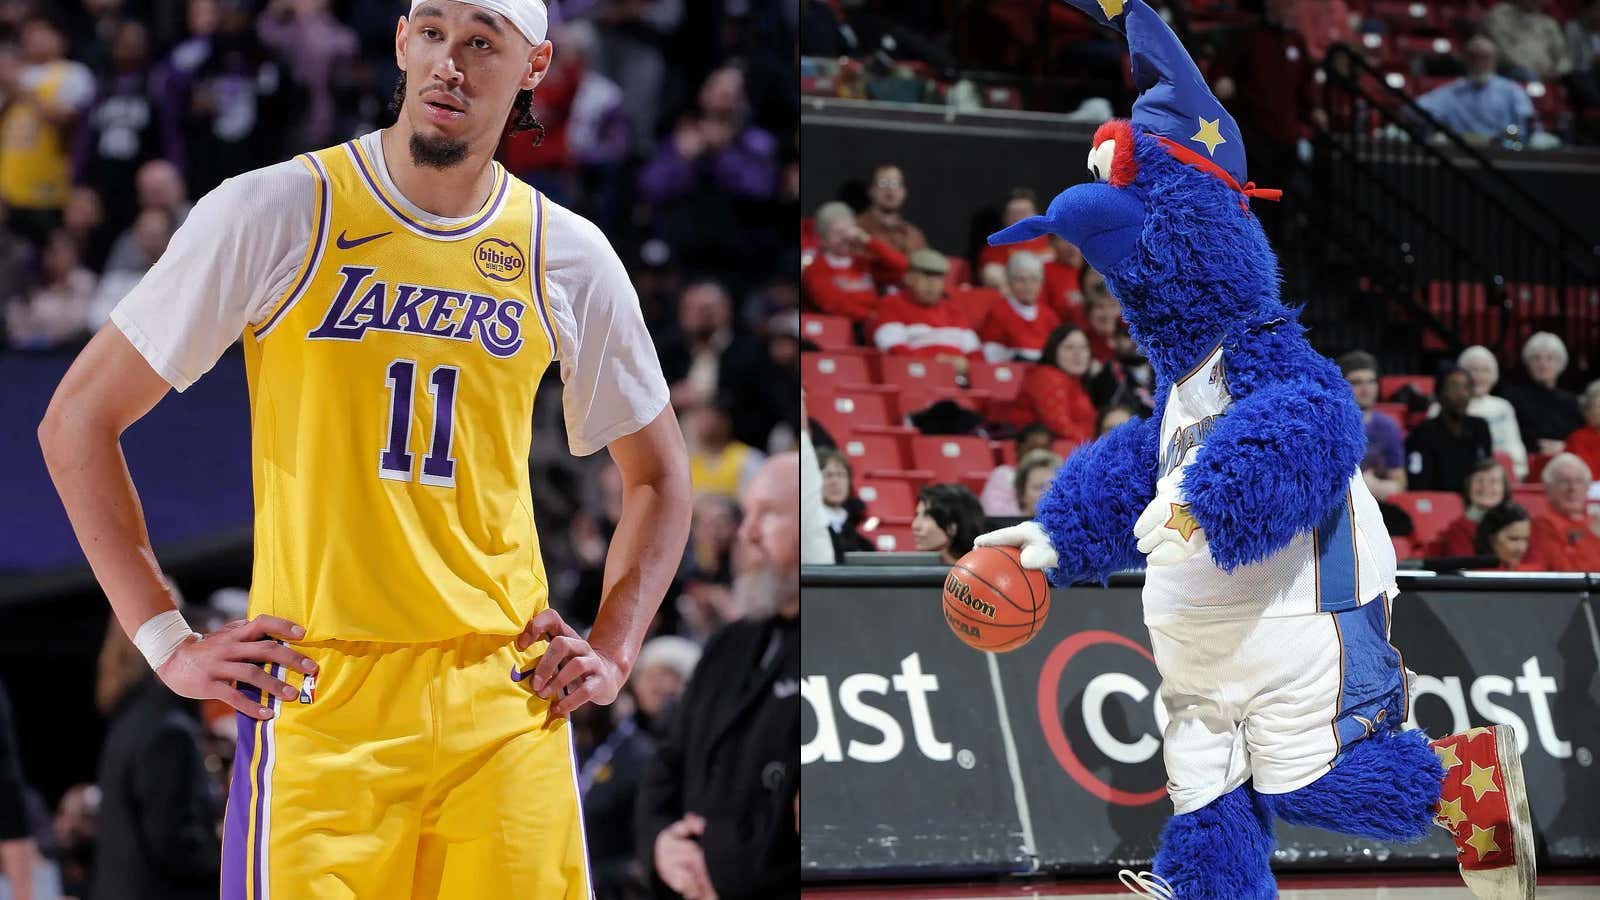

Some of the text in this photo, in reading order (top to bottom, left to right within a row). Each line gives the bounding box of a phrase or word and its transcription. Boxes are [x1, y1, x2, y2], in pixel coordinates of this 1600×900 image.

[479, 247, 522, 271] bibigo
[305, 265, 527, 359] LAKERS
[378, 358, 460, 488] 11
[946, 573, 996, 621] Wilson
